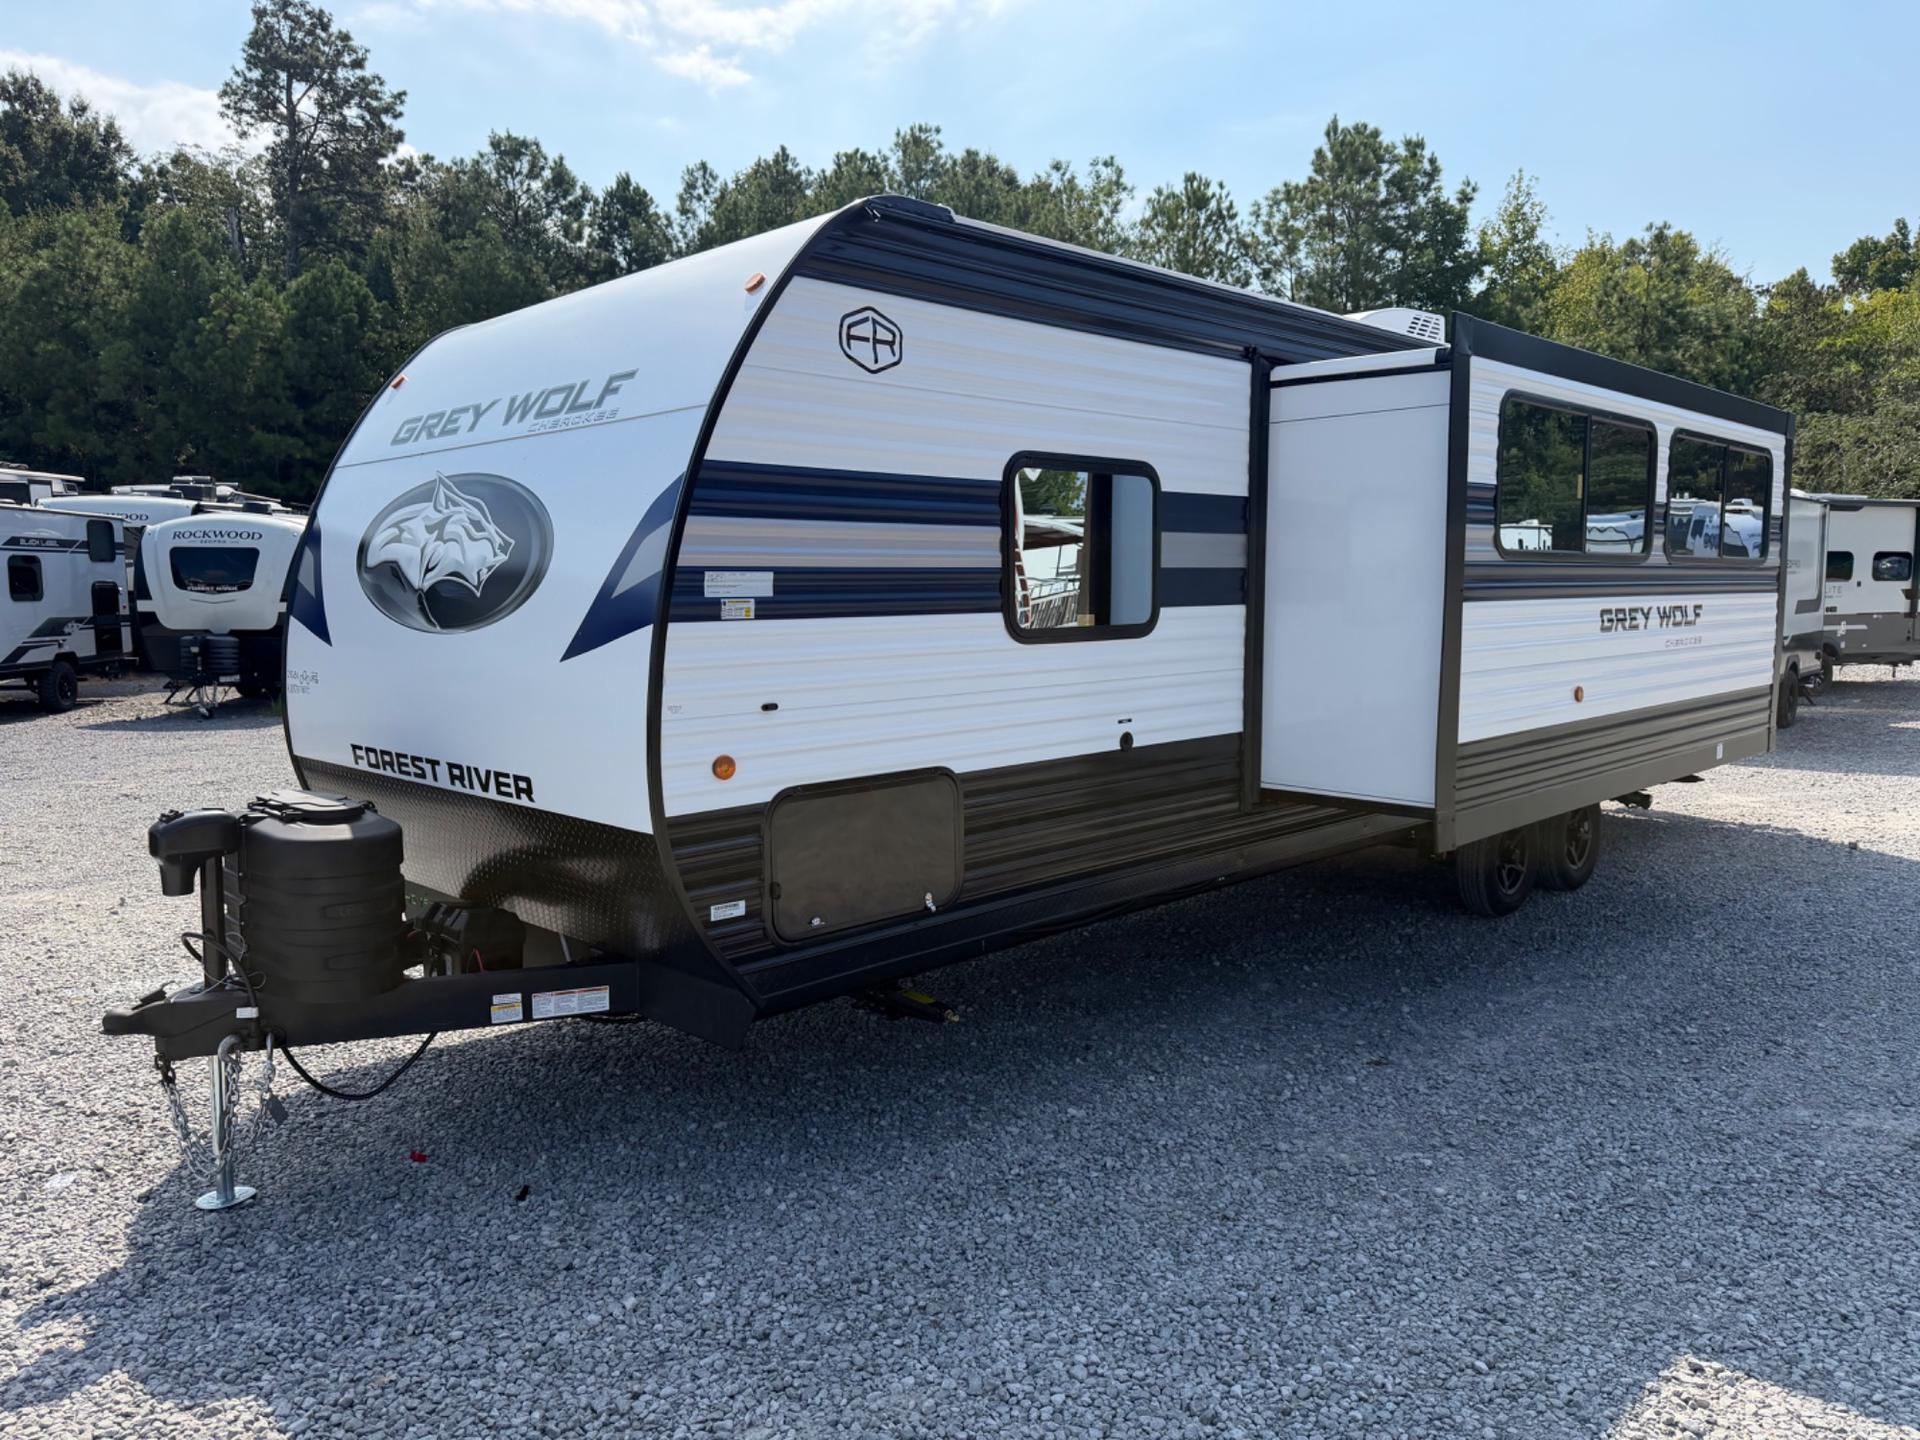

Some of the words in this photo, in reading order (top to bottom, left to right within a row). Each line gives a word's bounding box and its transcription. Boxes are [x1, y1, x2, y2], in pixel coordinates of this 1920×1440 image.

[390, 398, 502, 446] GREY
[502, 368, 639, 426] WOLF
[527, 407, 620, 433] CHEROKEE
[172, 530, 263, 541] ROCKWOOD
[1600, 606, 1653, 633] GREY
[1656, 604, 1703, 629] WOLF
[350, 743, 440, 782] FOREST
[445, 761, 535, 802] RIVER
